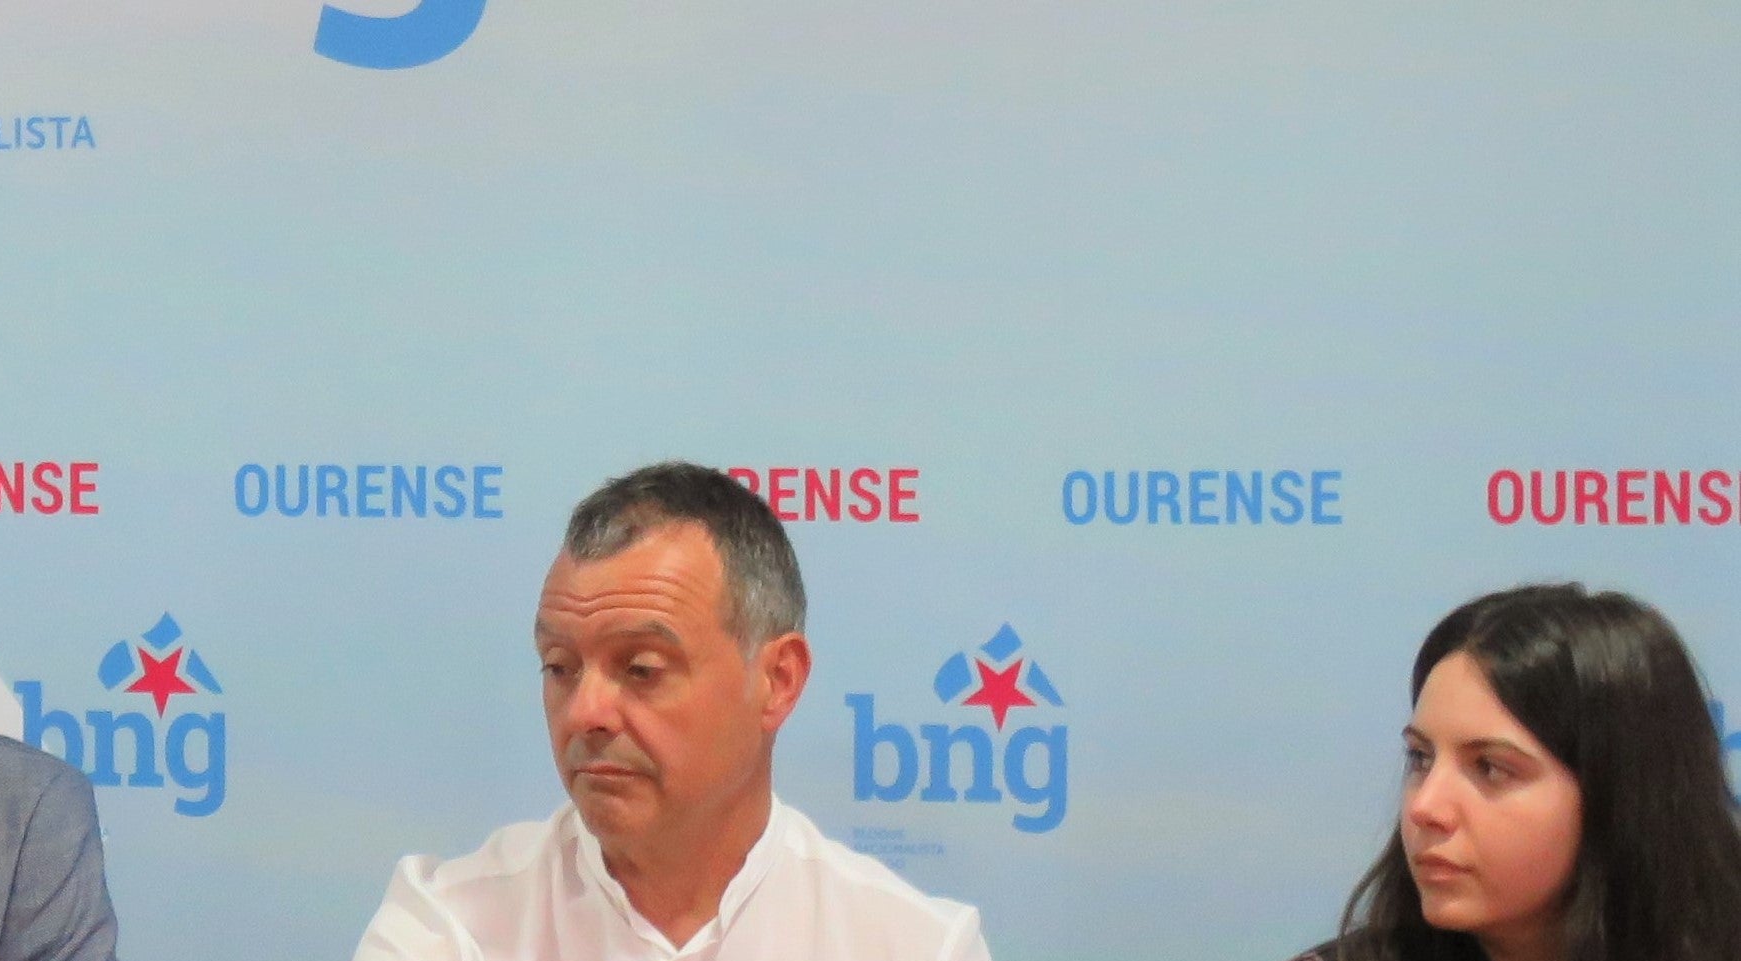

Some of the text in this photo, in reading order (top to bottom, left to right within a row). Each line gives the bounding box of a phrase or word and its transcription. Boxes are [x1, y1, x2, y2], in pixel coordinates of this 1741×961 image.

[234, 463, 504, 520] OURENSE
[1062, 470, 1343, 525] OURENSE
[1487, 470, 1741, 526] OURENS
[14, 680, 226, 818] bng
[845, 693, 1068, 834] bng
